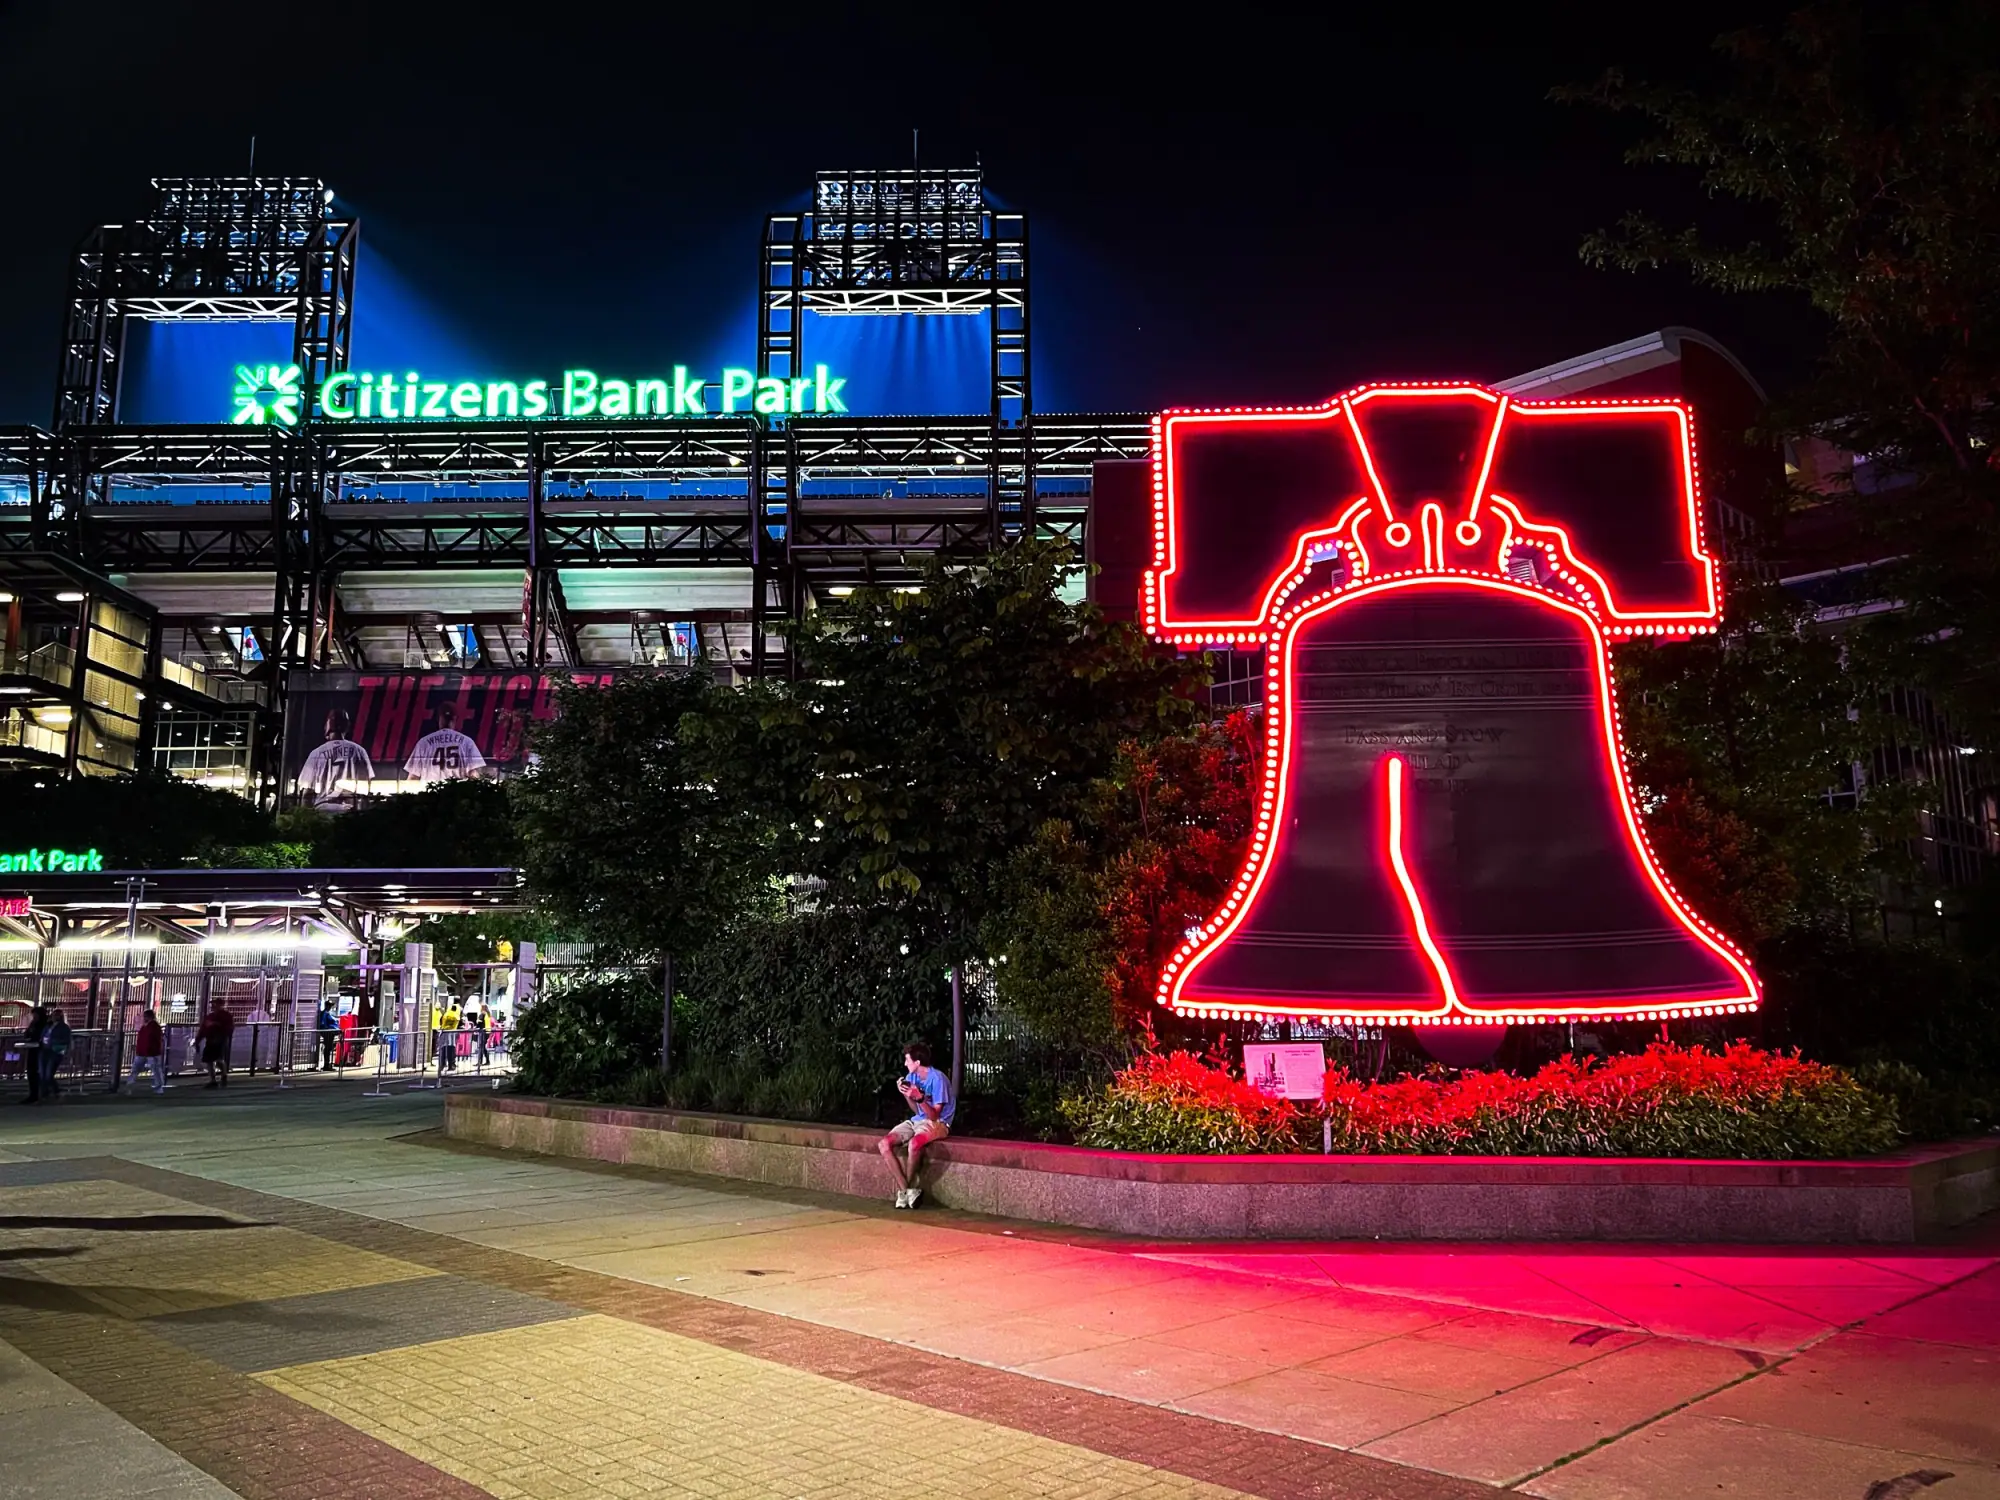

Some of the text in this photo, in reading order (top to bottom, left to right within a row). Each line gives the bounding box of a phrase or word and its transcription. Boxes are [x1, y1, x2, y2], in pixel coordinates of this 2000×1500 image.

[320, 363, 849, 419] Citizens Bank Park
[352, 675, 442, 763] THE
[427, 733, 465, 745] WHEELER
[320, 745, 355, 760] TURNER
[432, 745, 460, 771] 45
[0, 848, 103, 872] ank Park
